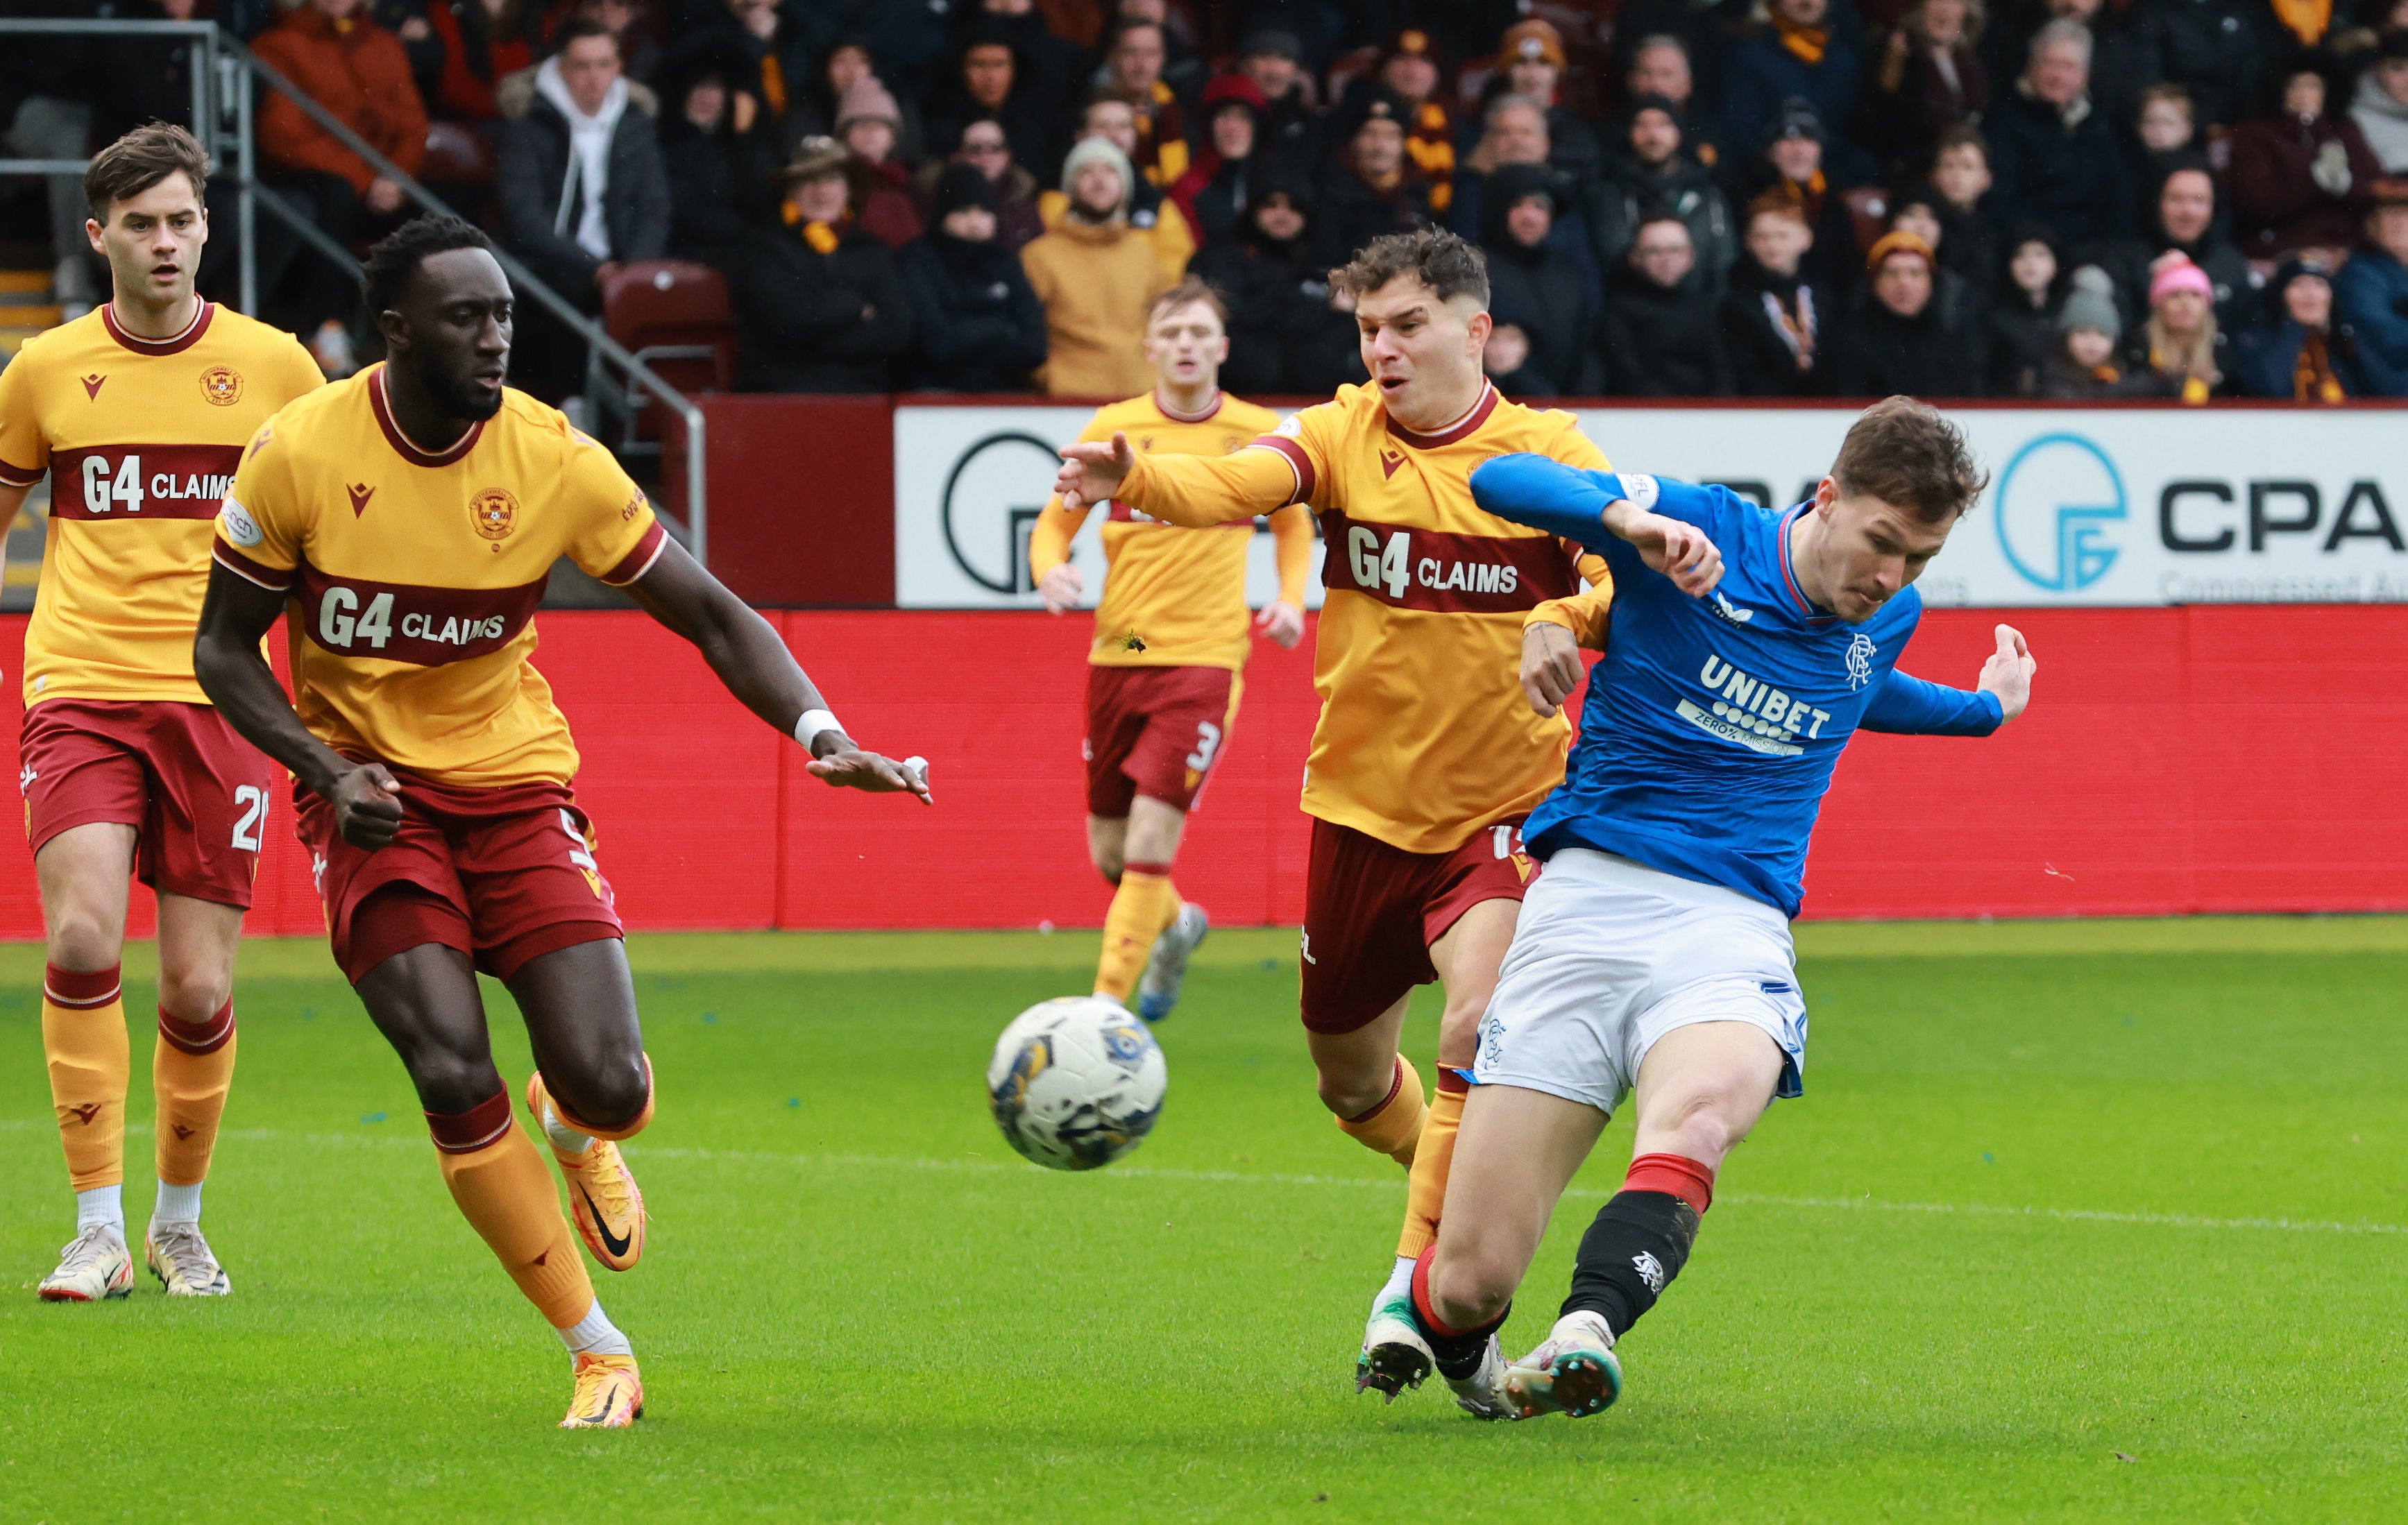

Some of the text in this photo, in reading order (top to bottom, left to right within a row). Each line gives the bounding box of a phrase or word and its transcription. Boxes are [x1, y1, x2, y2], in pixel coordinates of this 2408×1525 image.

[82, 454, 144, 513] G4
[2157, 479, 2407, 553] CPA
[1348, 526, 1518, 599] G4 CLAIMS
[319, 586, 505, 649] G4 CLAIMS
[1700, 654, 1831, 740] UNIBET
[1186, 720, 1221, 772] 3
[1740, 733, 1789, 756] MISSION
[1488, 825, 1527, 860] 1
